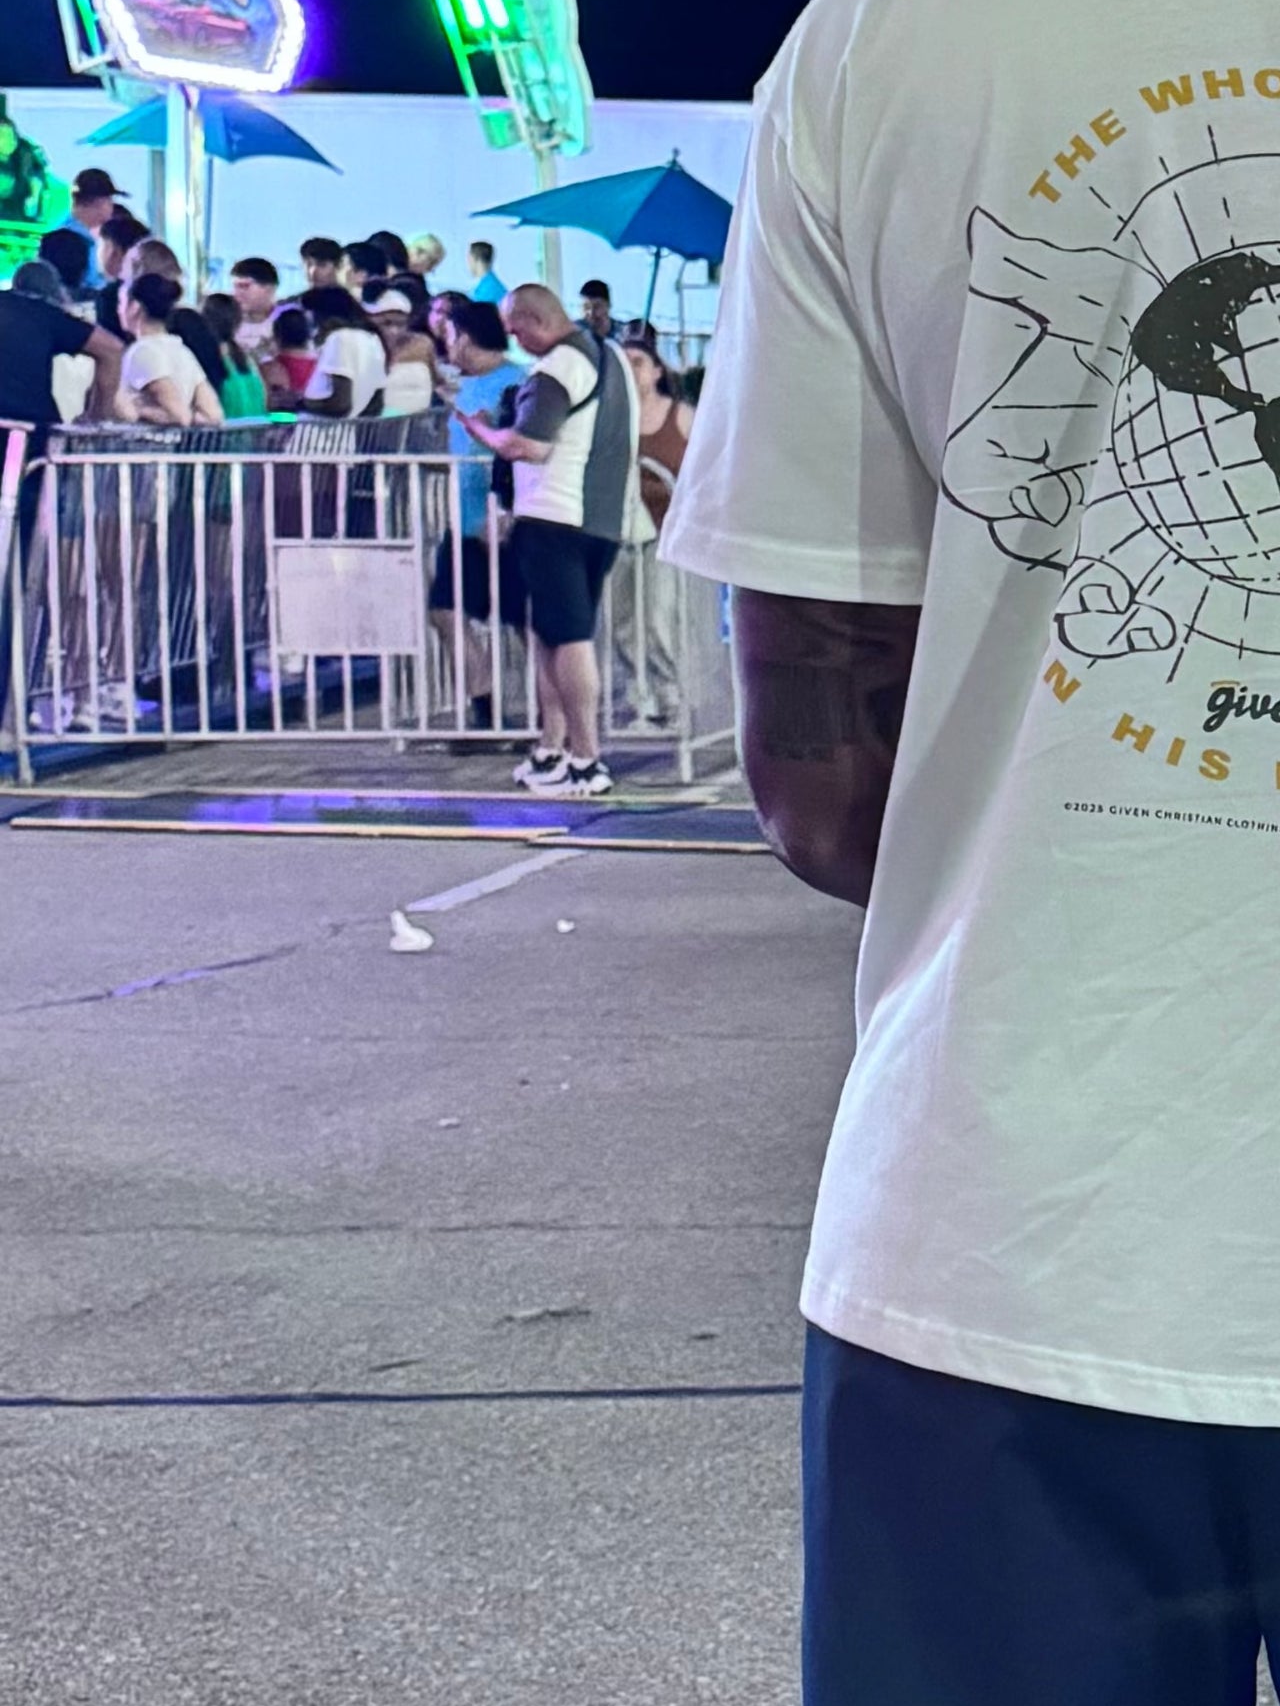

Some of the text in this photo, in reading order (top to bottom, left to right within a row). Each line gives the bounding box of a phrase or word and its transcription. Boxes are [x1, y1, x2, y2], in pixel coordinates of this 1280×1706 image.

[1028, 111, 1124, 203] THE
[1043, 659, 1082, 704] N
[1112, 712, 1231, 782] HIS
[1109, 804, 1150, 818] GIVEN
[1154, 809, 1223, 826] CHRISTIAN
